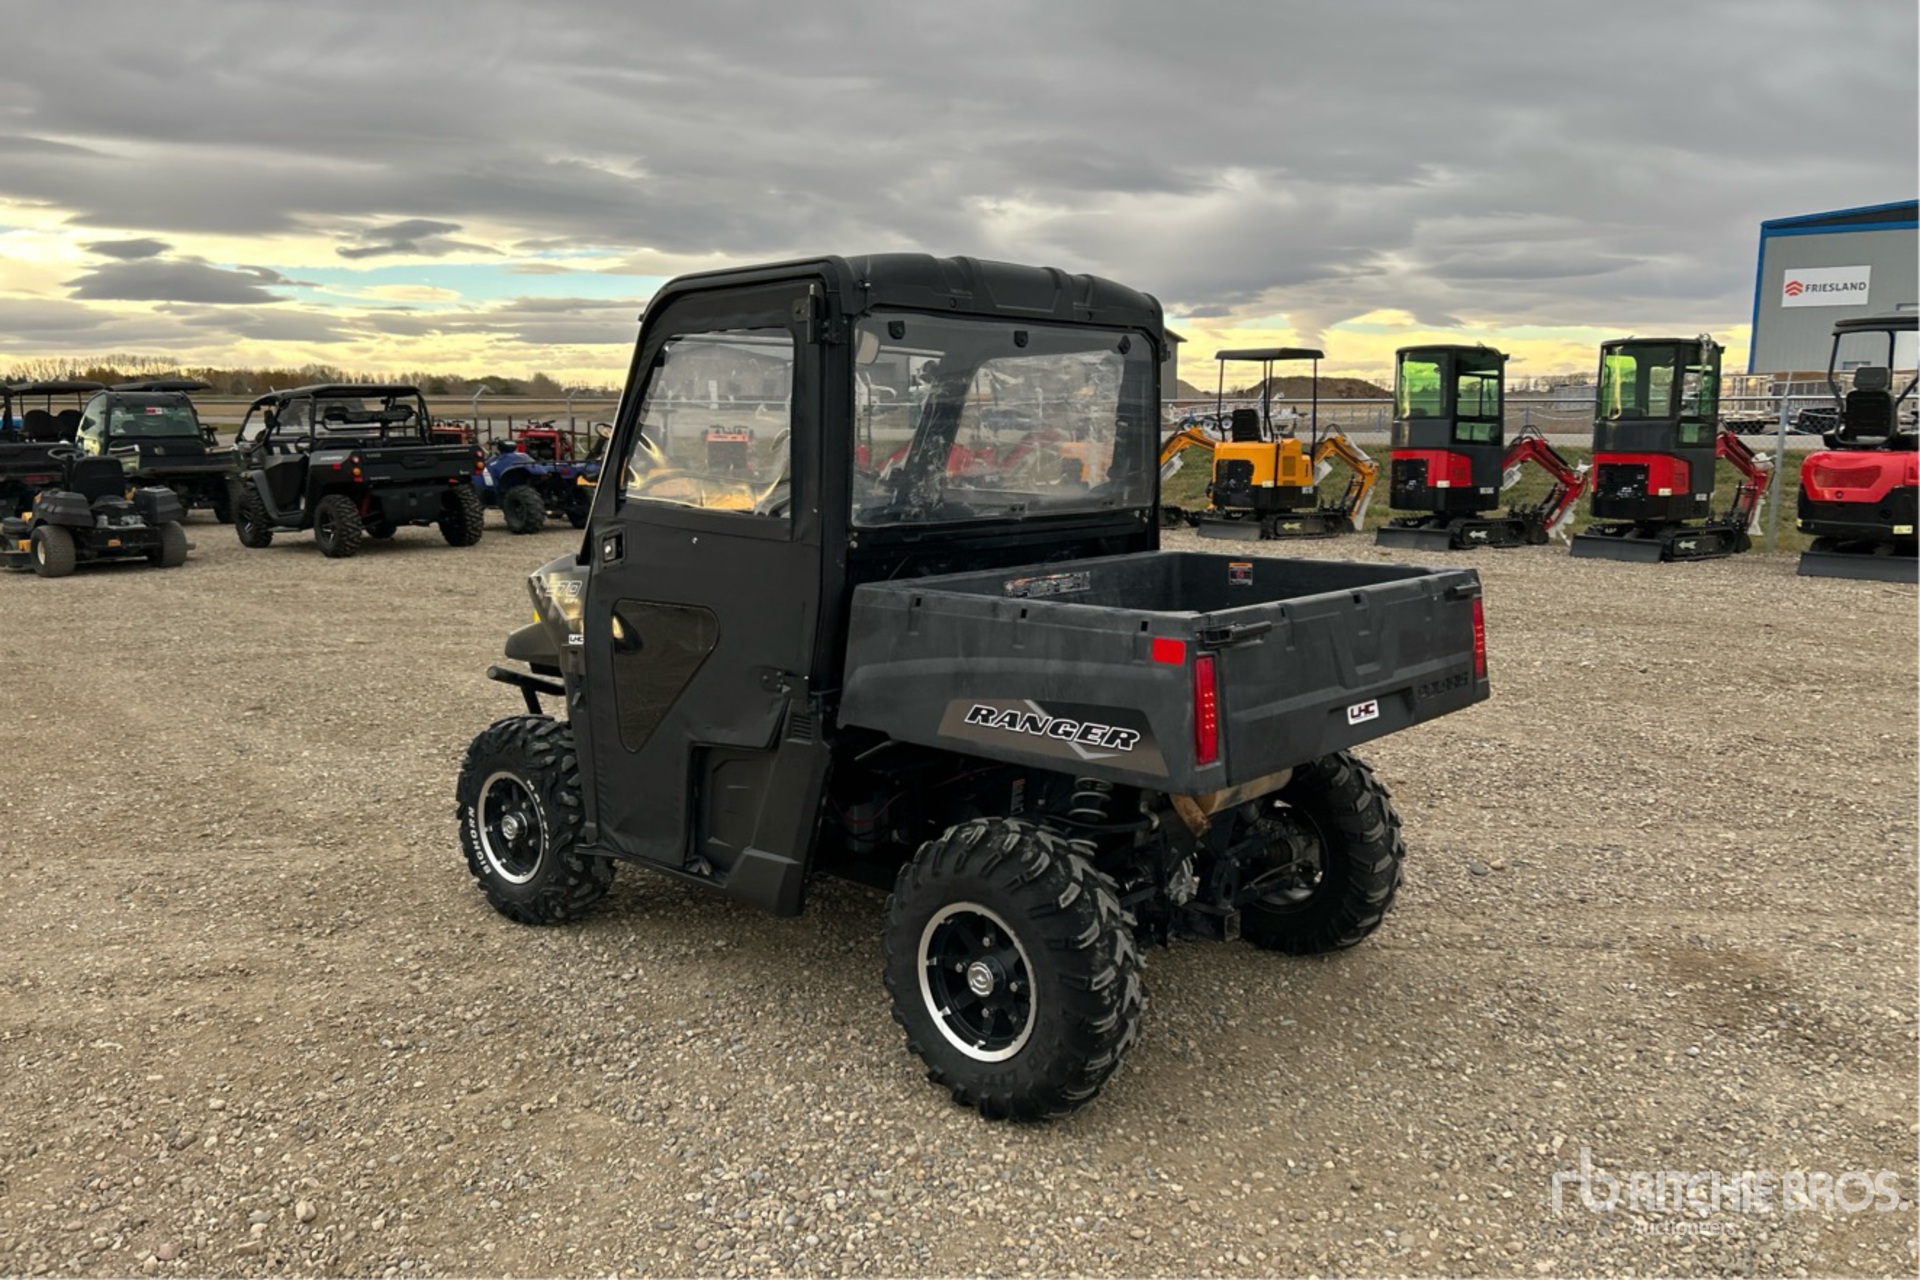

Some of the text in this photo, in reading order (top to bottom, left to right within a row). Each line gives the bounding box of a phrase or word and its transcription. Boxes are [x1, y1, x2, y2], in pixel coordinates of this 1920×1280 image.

[1804, 281, 1867, 293] FRIESLAND
[1350, 702, 1376, 719] LHC
[964, 704, 1140, 751] RANGER
[468, 806, 492, 875] BIGHORN
